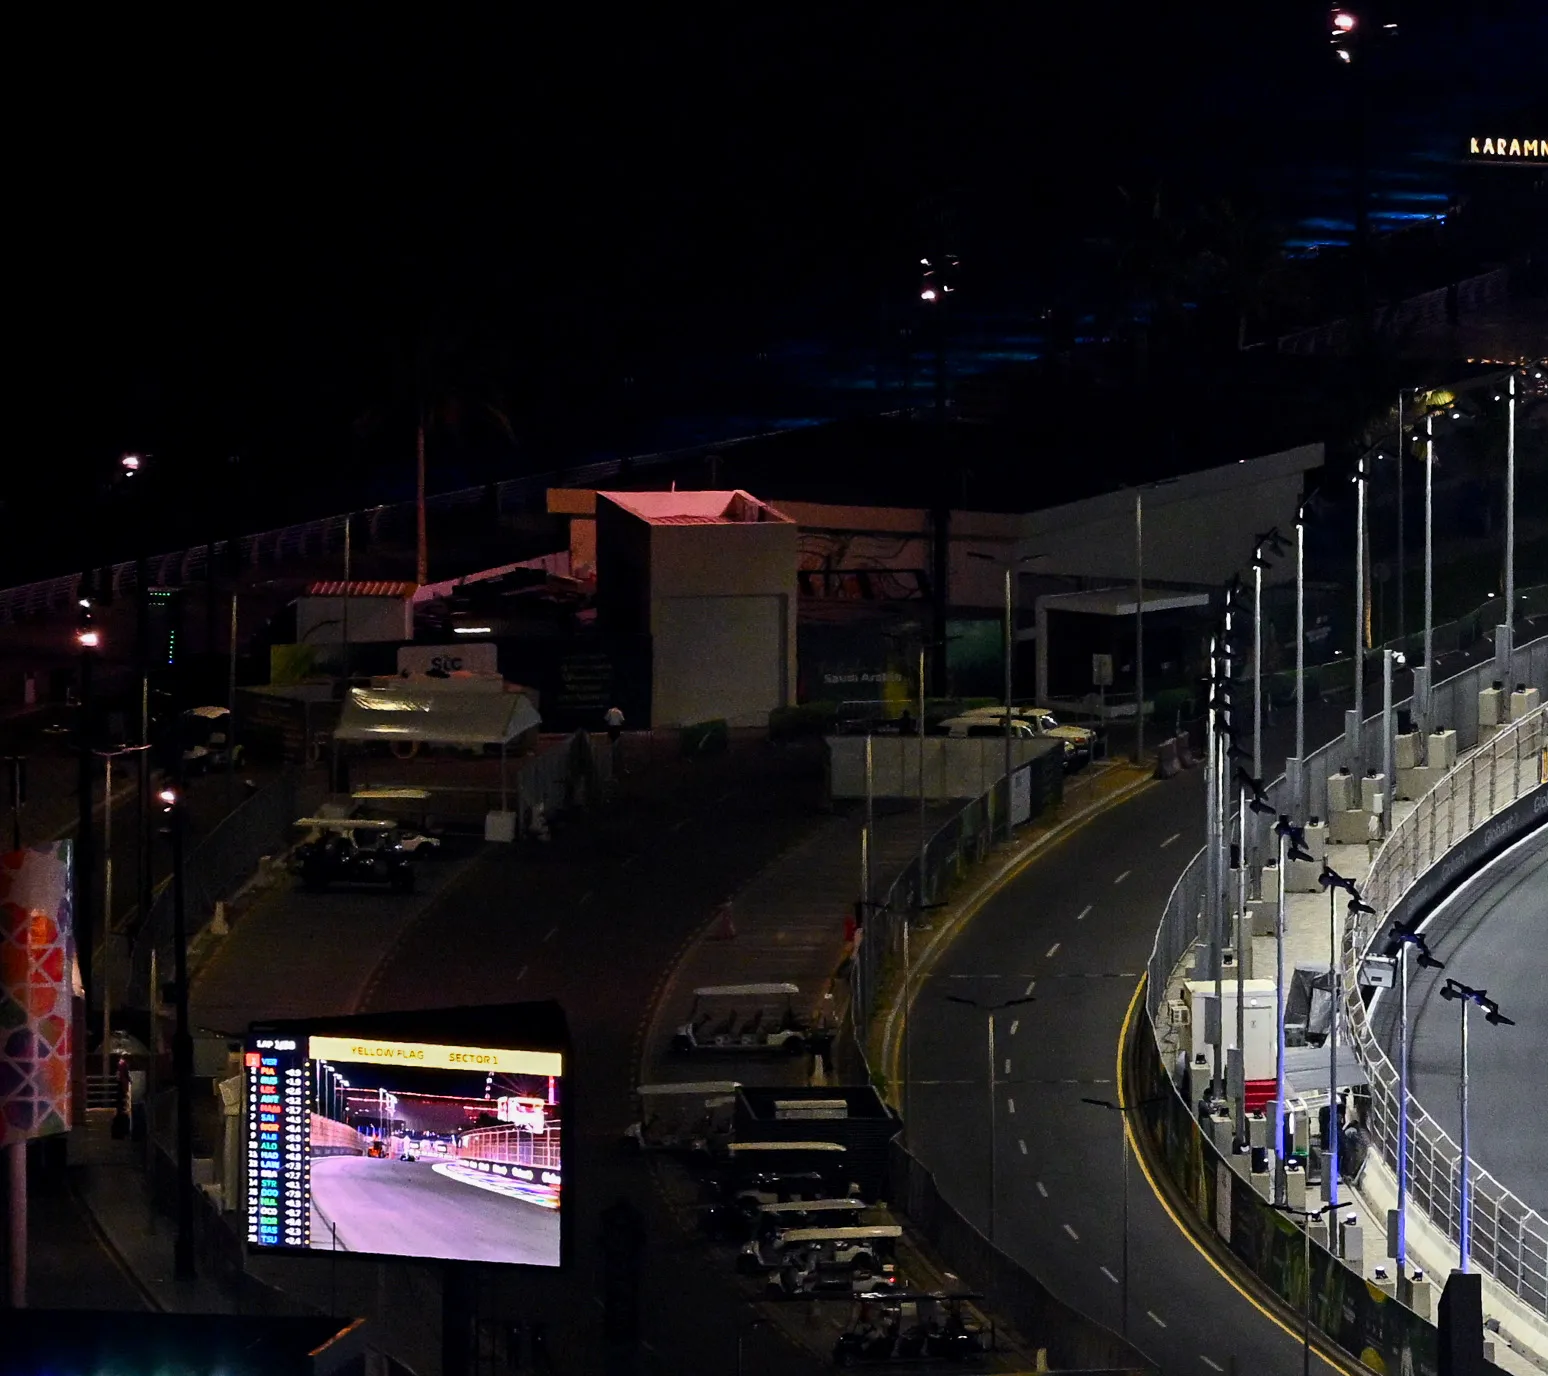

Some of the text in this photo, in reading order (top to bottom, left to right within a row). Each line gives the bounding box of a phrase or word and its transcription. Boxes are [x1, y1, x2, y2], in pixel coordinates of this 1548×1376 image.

[352, 1047, 498, 1064] YELLOW FLAG SECTOR 1
[260, 1114, 275, 1122] SAI
[260, 1179, 277, 1187] STR
